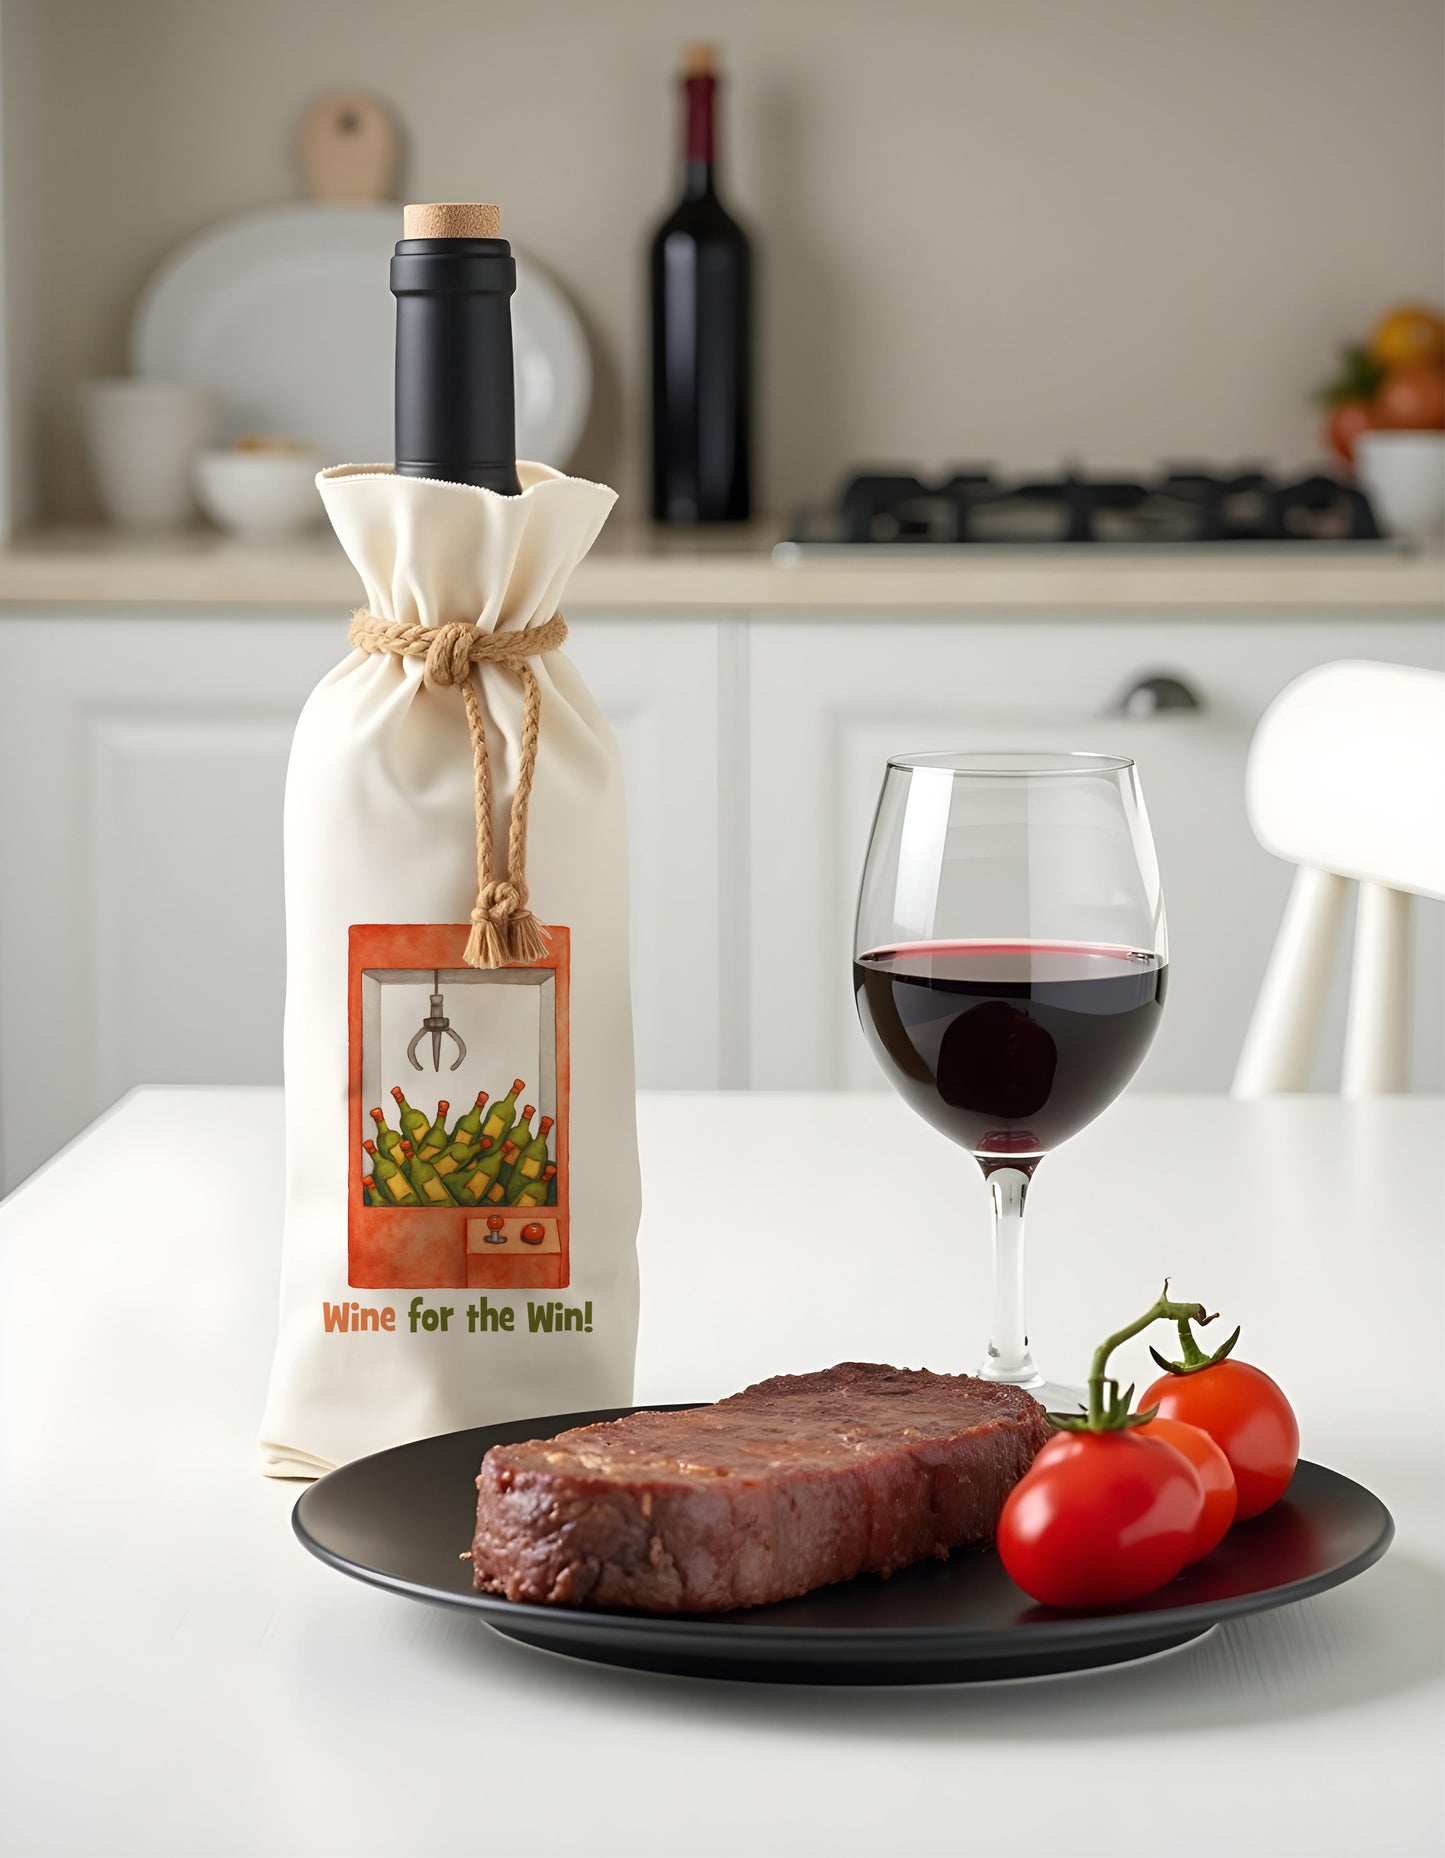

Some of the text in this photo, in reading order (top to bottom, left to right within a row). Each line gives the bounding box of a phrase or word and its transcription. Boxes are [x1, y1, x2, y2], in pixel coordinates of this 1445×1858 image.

[322, 1296, 594, 1333] Wine for the Win!
